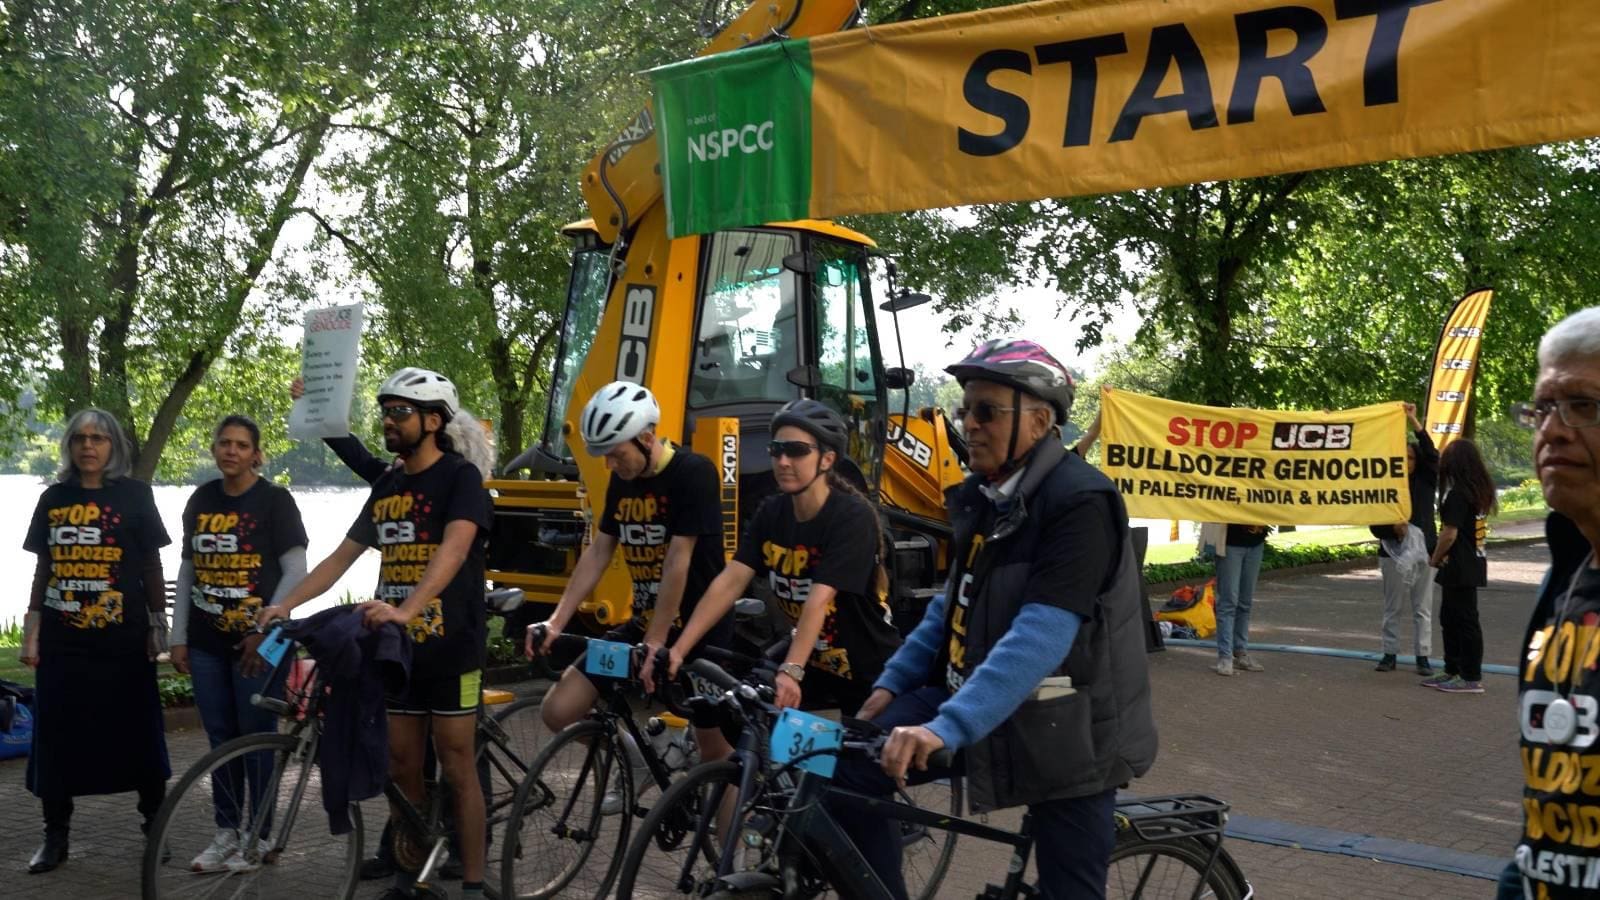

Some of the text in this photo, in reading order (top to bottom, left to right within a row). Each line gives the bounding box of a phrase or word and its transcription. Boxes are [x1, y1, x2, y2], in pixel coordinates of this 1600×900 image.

[958, 0, 1443, 157] START
[688, 121, 774, 164] NSPCC
[617, 288, 653, 387] CB
[887, 426, 931, 466] JCB
[1167, 416, 1350, 449] STOP JCB
[723, 436, 736, 483] 3CX
[1107, 444, 1404, 480] BULLDOZER GENOCIDE
[1140, 480, 1241, 504] PALESTINE,
[1247, 488, 1294, 504] INDIA
[1300, 490, 1312, 504] &
[1318, 488, 1398, 504] KASHMIR
[47, 504, 100, 526] STOP
[197, 512, 240, 533] TOP
[372, 495, 414, 522] STOP
[614, 498, 657, 522] STOP
[599, 654, 614, 670] 46
[789, 733, 815, 755] 34
